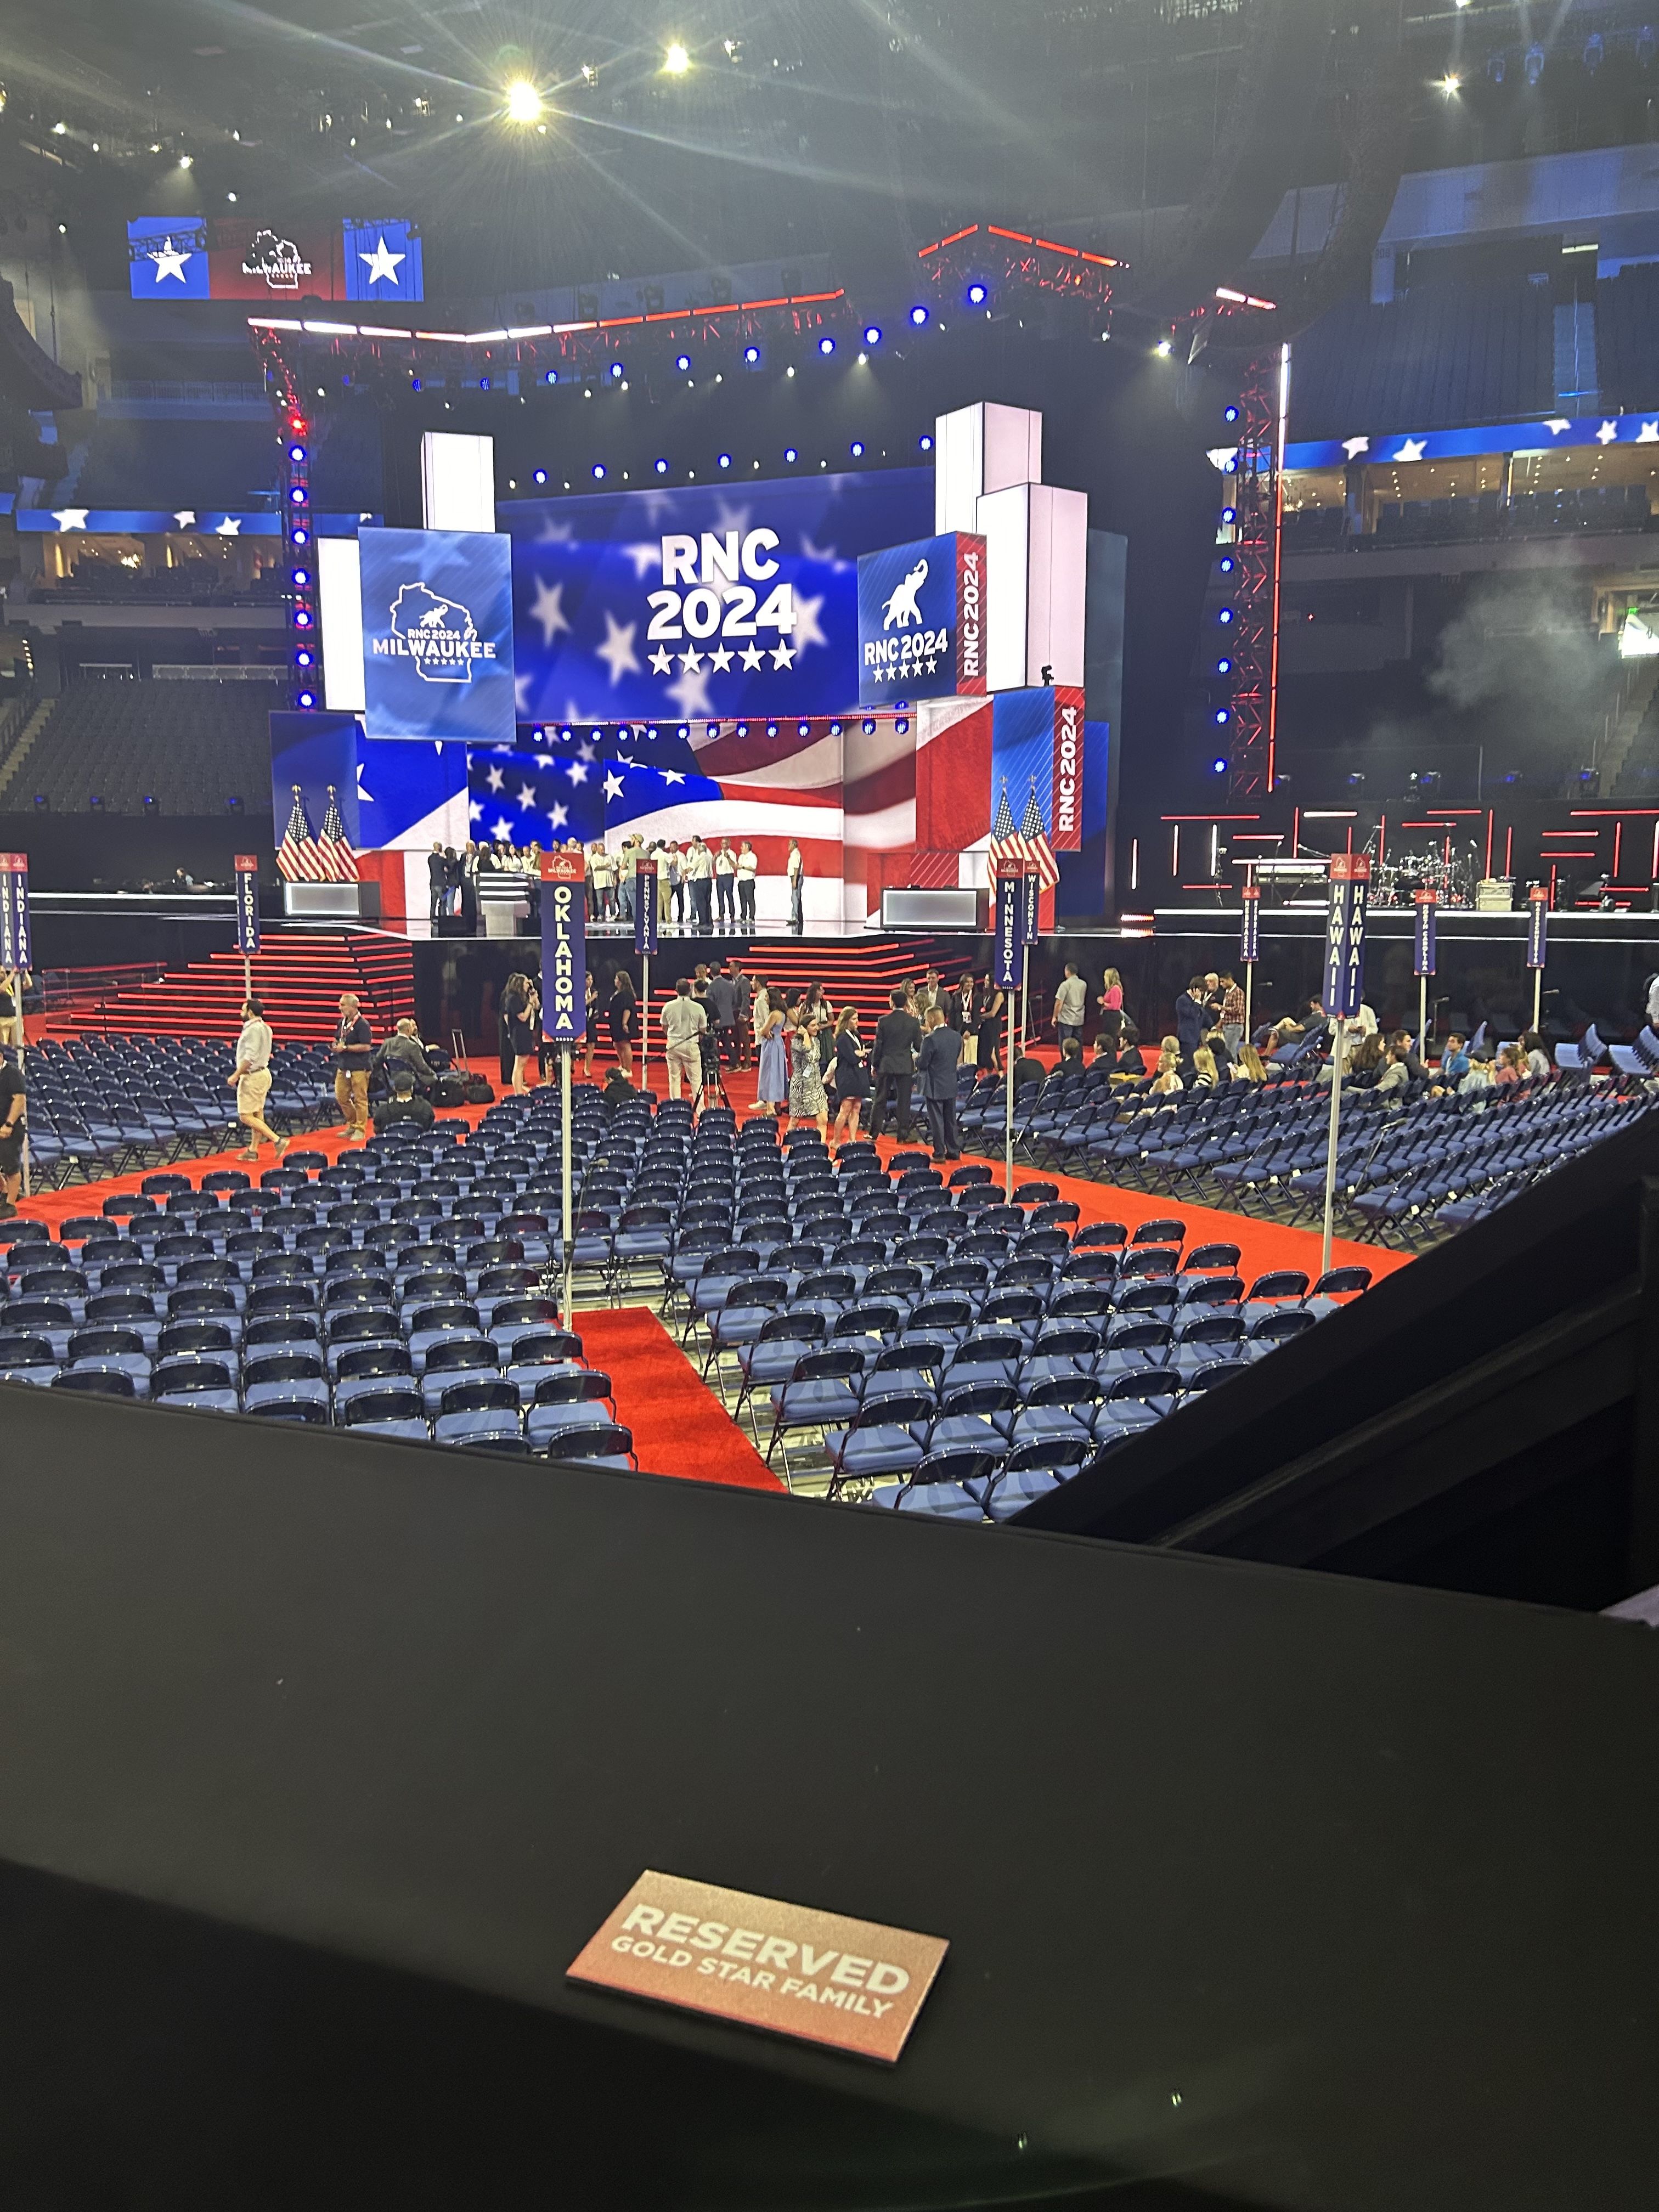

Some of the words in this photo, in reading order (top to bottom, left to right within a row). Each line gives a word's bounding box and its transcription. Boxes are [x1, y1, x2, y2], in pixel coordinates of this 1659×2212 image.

[662, 528, 780, 585] RNC
[373, 639, 496, 658] MILWAUKEE
[647, 583, 797, 640] 2024
[2, 874, 12, 963] INDIANA
[16, 874, 27, 963] INDIANA
[244, 872, 256, 948] FLORIDA
[1003, 881, 1015, 982] MINNESOTA
[1026, 874, 1036, 940] WISCONSIN
[1329, 884, 1344, 1007] HAWAII
[1348, 885, 1363, 1007] HAWAII
[554, 886, 573, 1030] OKLAHOMA
[611, 1935, 693, 1967] GOLD
[697, 1957, 776, 1992] STAR
[780, 1977, 894, 2019] FAMILY
[621, 1903, 909, 1994] RESERVED
